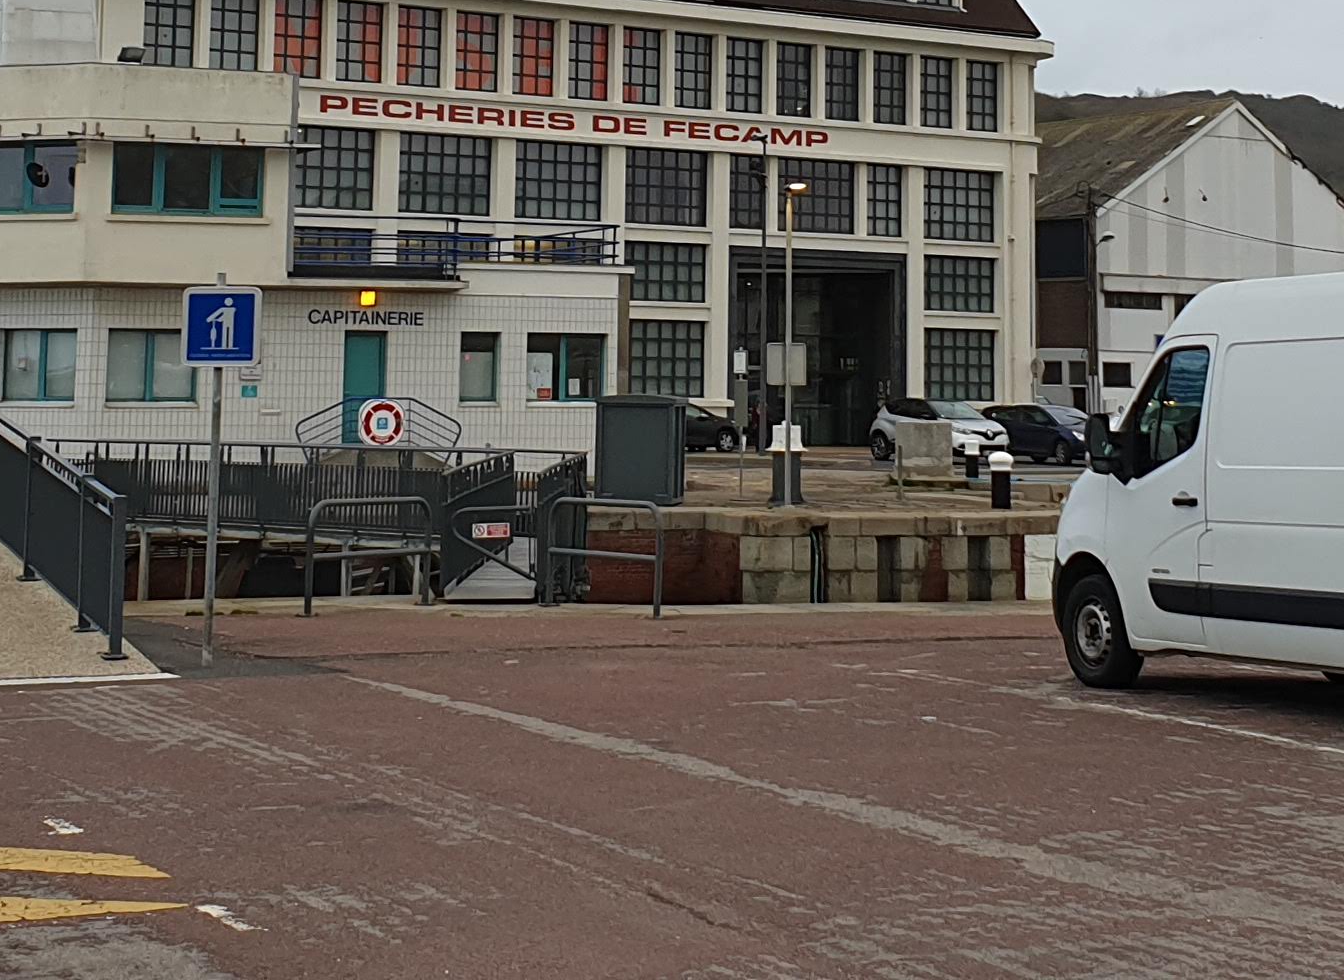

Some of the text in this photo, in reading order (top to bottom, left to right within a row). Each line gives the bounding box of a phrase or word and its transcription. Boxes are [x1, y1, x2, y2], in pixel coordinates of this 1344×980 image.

[319, 94, 829, 147] PECHERIES DE FECAMP
[307, 309, 424, 327] CAPITAINERIE
